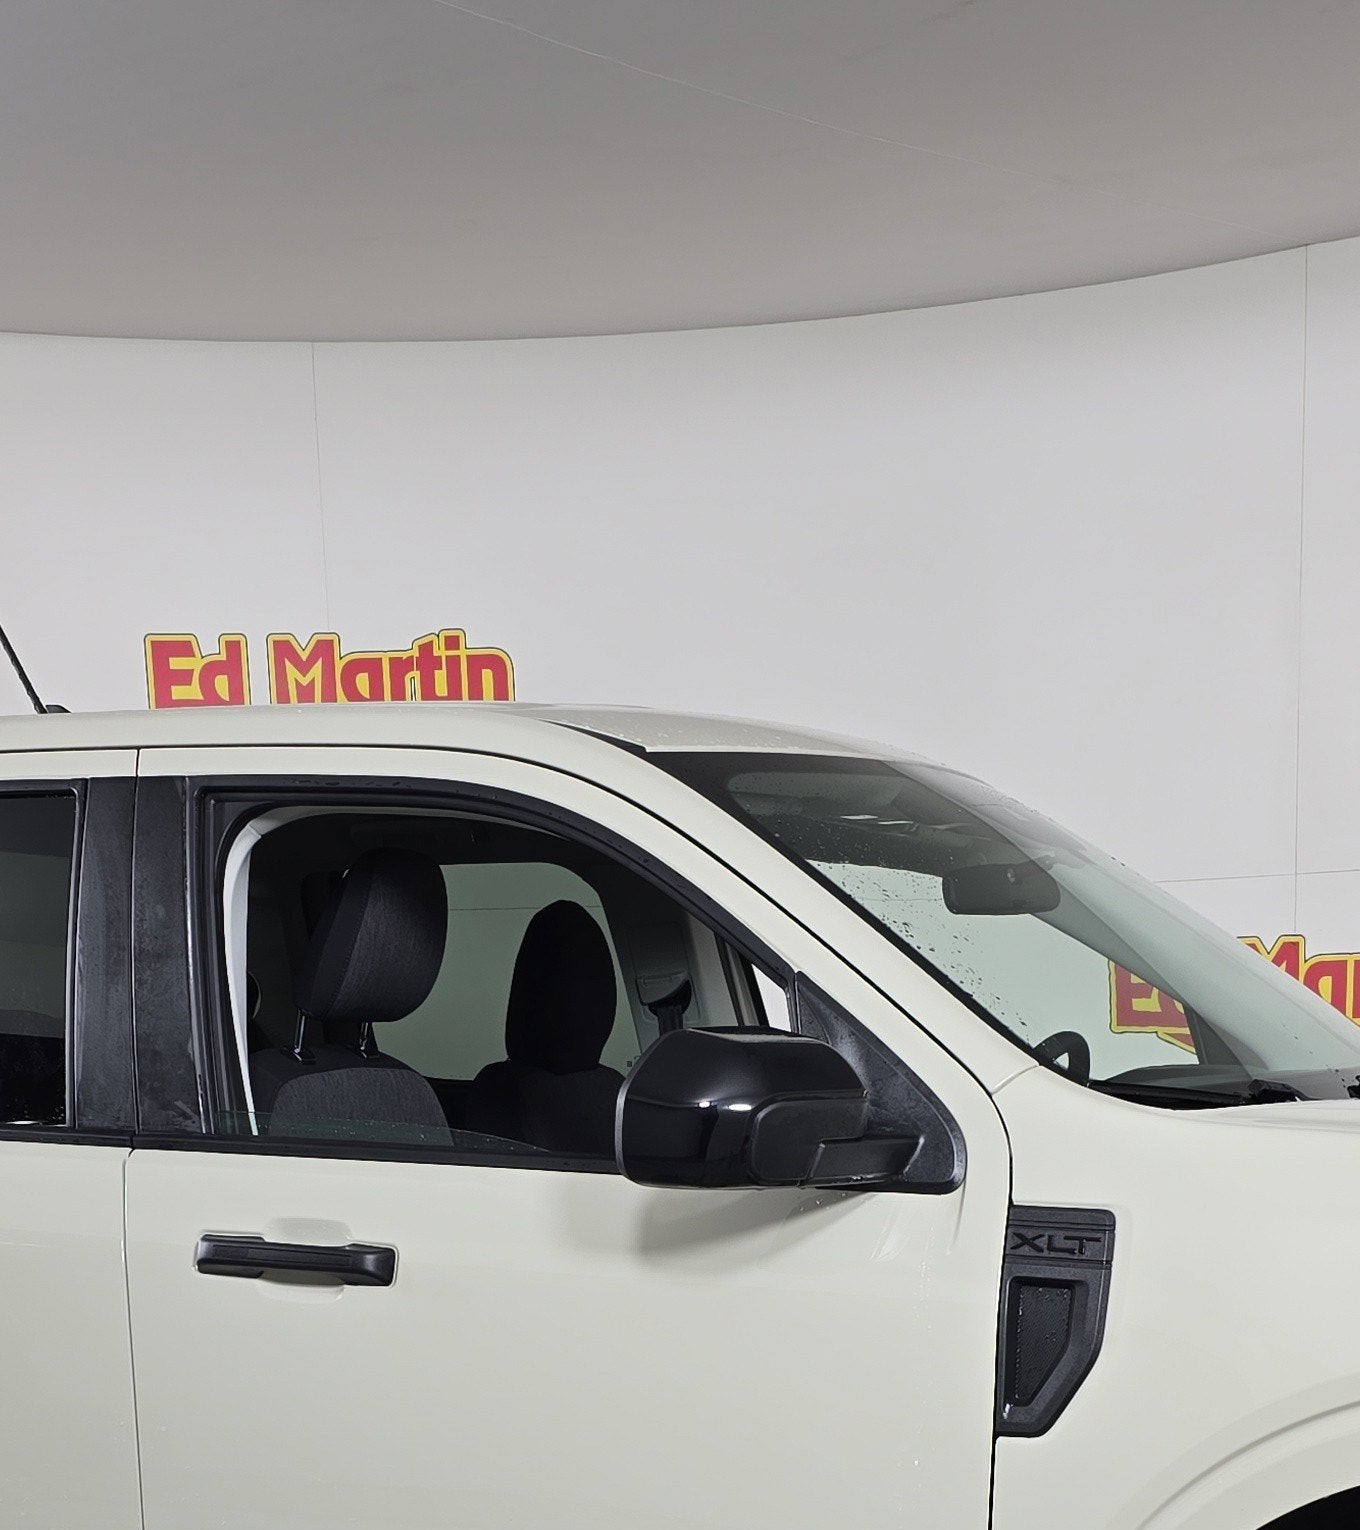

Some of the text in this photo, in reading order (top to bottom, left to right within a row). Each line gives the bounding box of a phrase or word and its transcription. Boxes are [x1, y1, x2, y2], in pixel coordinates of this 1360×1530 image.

[150, 634, 509, 708] Ed Martin
[1011, 1231, 1102, 1256] XLT
